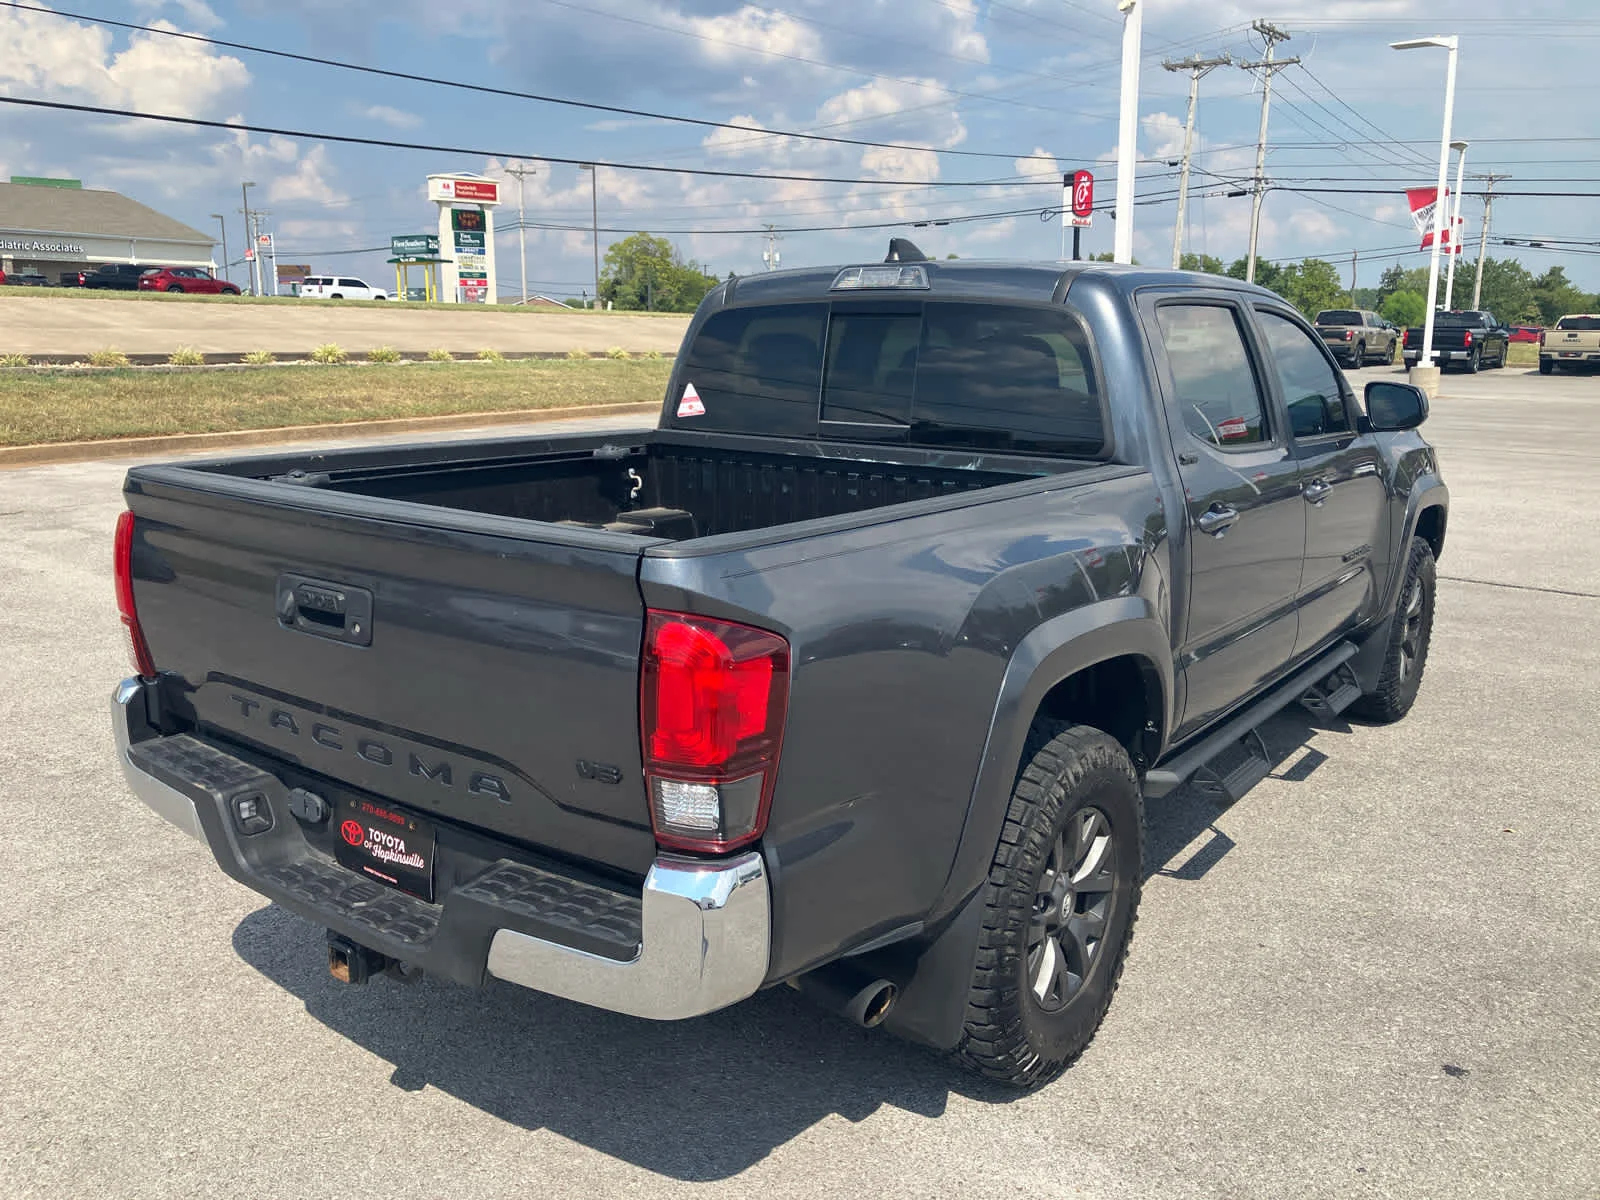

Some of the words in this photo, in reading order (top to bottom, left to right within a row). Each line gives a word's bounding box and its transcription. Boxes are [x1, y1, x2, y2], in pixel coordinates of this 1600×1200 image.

[33, 241, 84, 253] Associates
[230, 694, 511, 805] TACOMA
[368, 827, 405, 853] TOYOTA
[371, 844, 424, 868] Hopkinsville
